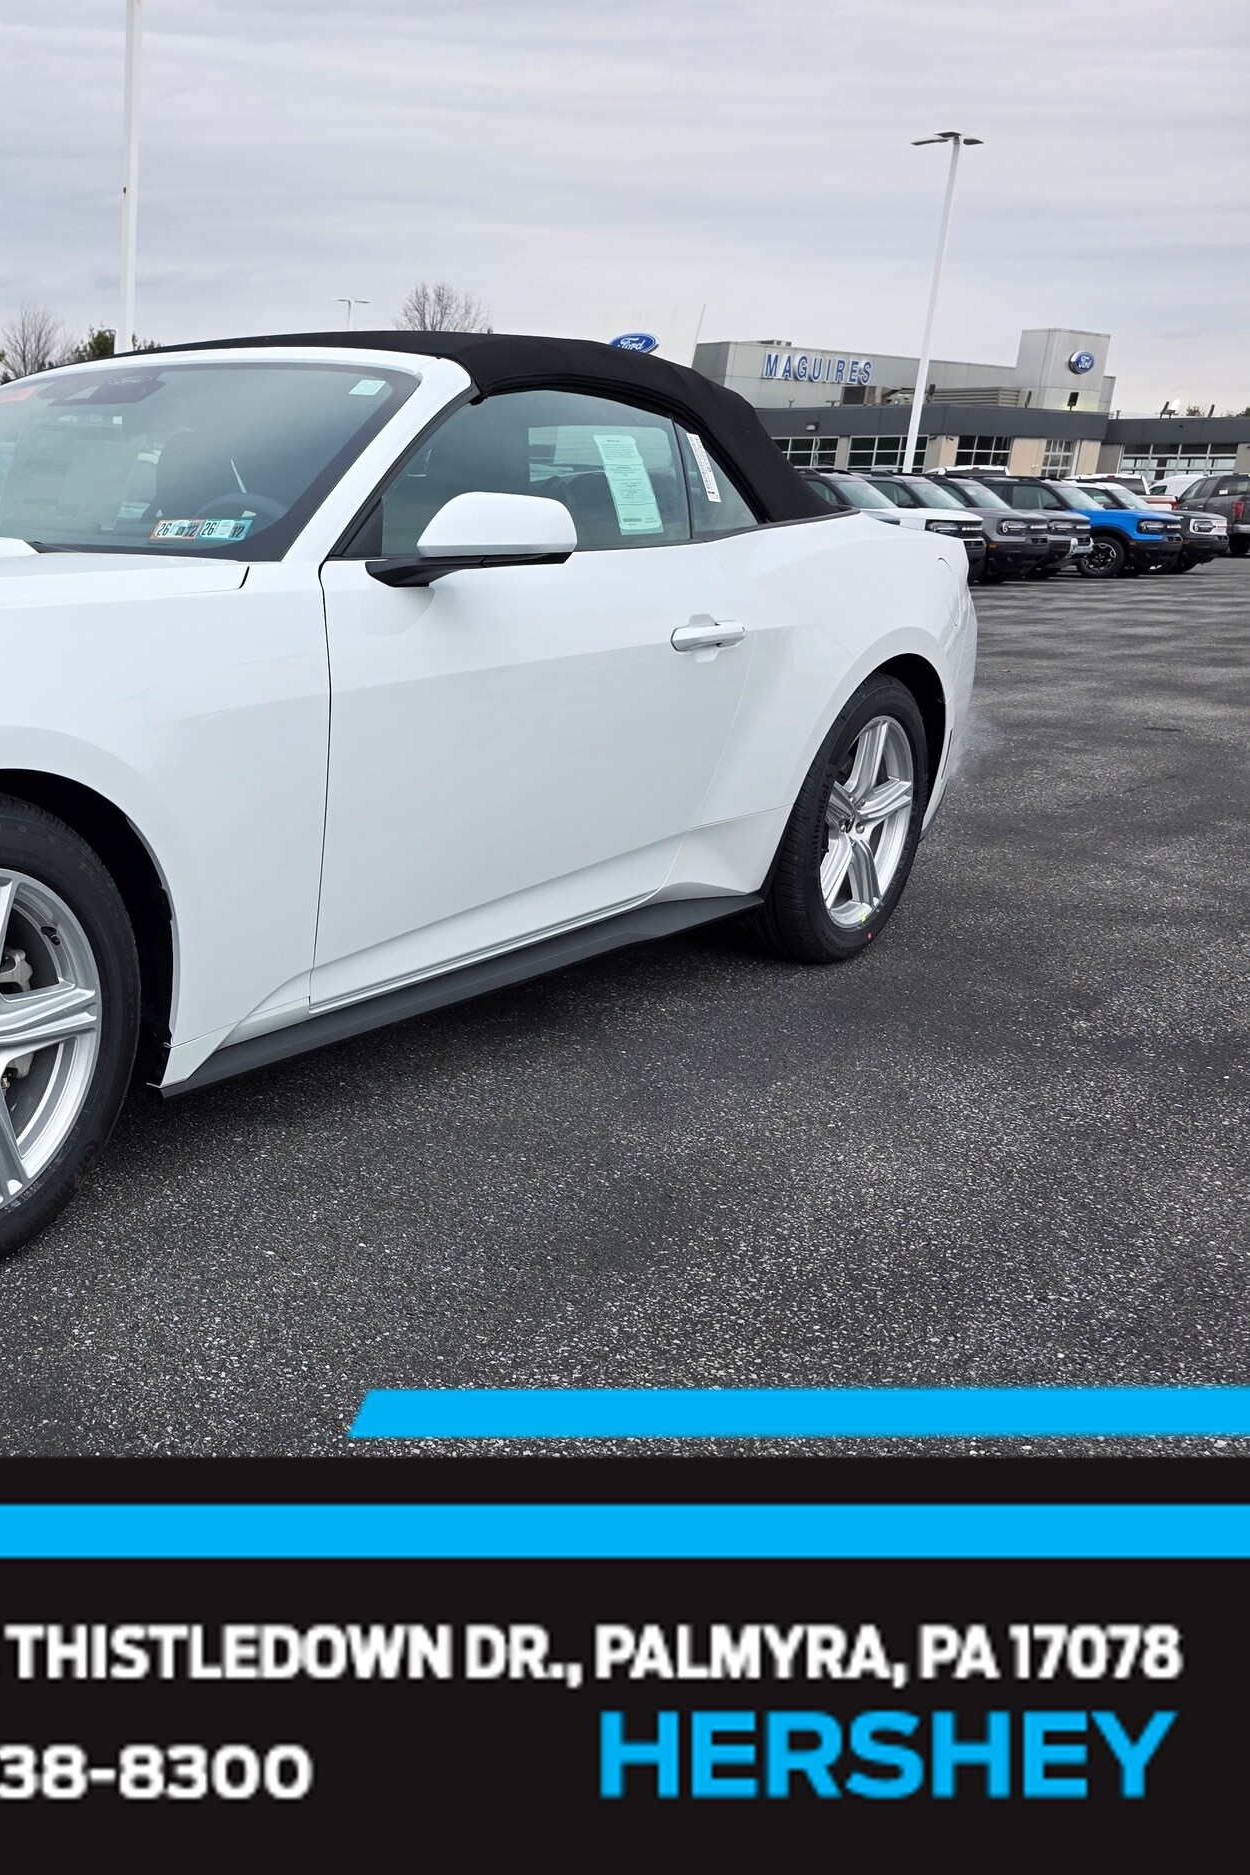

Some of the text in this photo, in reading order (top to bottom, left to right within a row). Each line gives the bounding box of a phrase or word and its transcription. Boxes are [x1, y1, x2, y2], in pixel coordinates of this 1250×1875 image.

[764, 353, 873, 385] MAGUIRES
[157, 523, 172, 536] 26
[202, 522, 216, 536] 26
